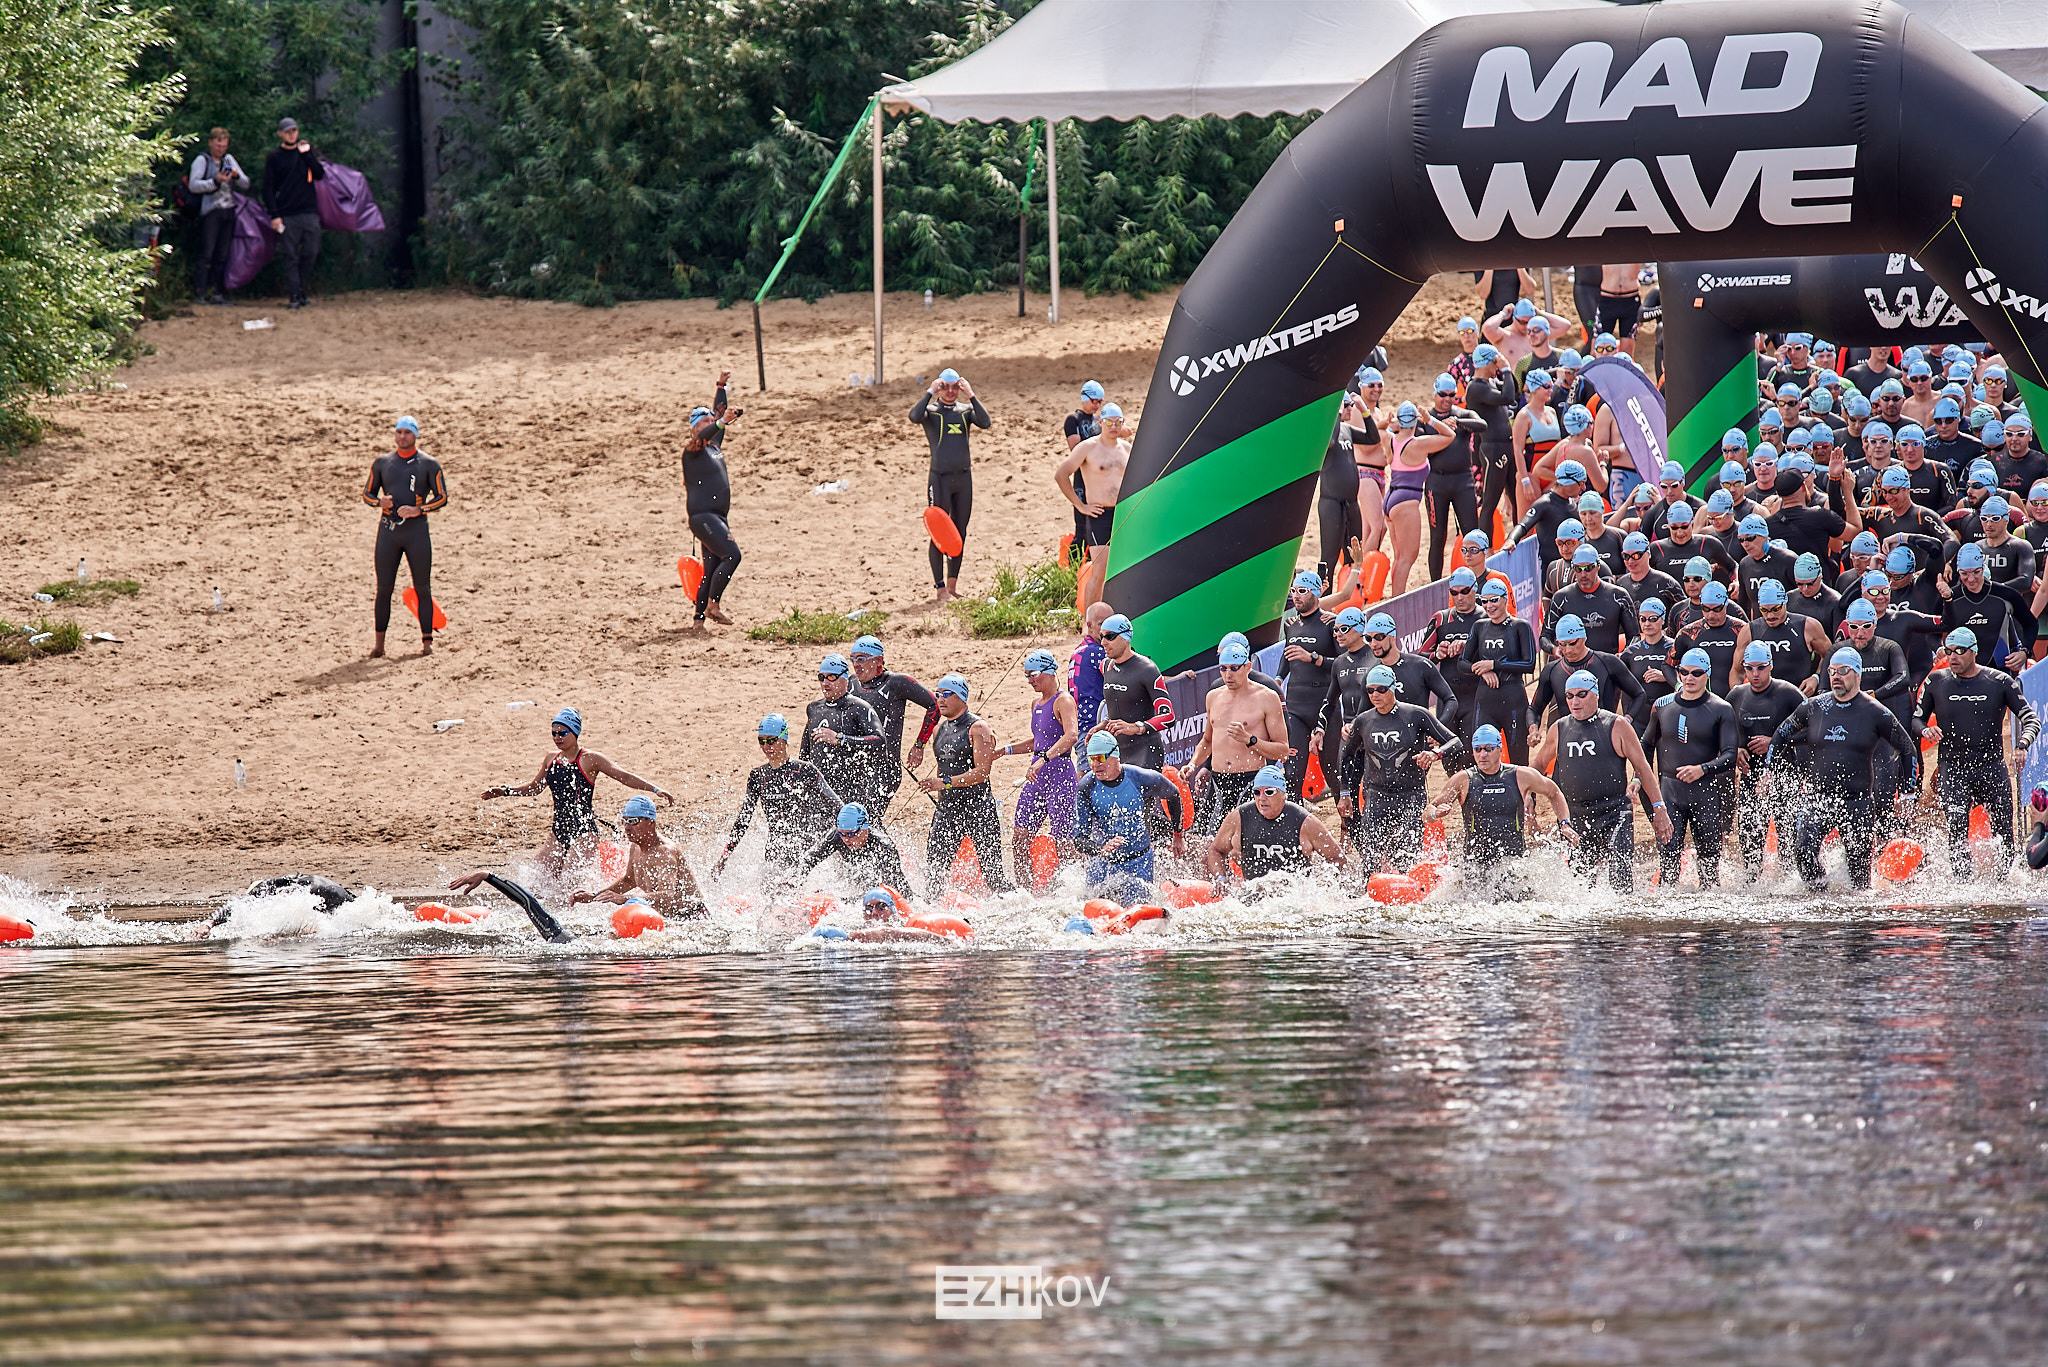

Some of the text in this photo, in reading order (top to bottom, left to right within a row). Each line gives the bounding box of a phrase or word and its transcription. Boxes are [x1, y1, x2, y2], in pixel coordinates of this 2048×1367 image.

[1463, 32, 1823, 129] MAD
[1425, 144, 1858, 242] WAVE
[1288, 636, 1317, 644] orca
[1485, 638, 1505, 649] TYR
[1103, 682, 1129, 692] orca
[1948, 694, 1988, 702] orca
[1371, 731, 1401, 744] TYR
[1566, 740, 1597, 758] TYR
[1253, 843, 1286, 862] TYR
